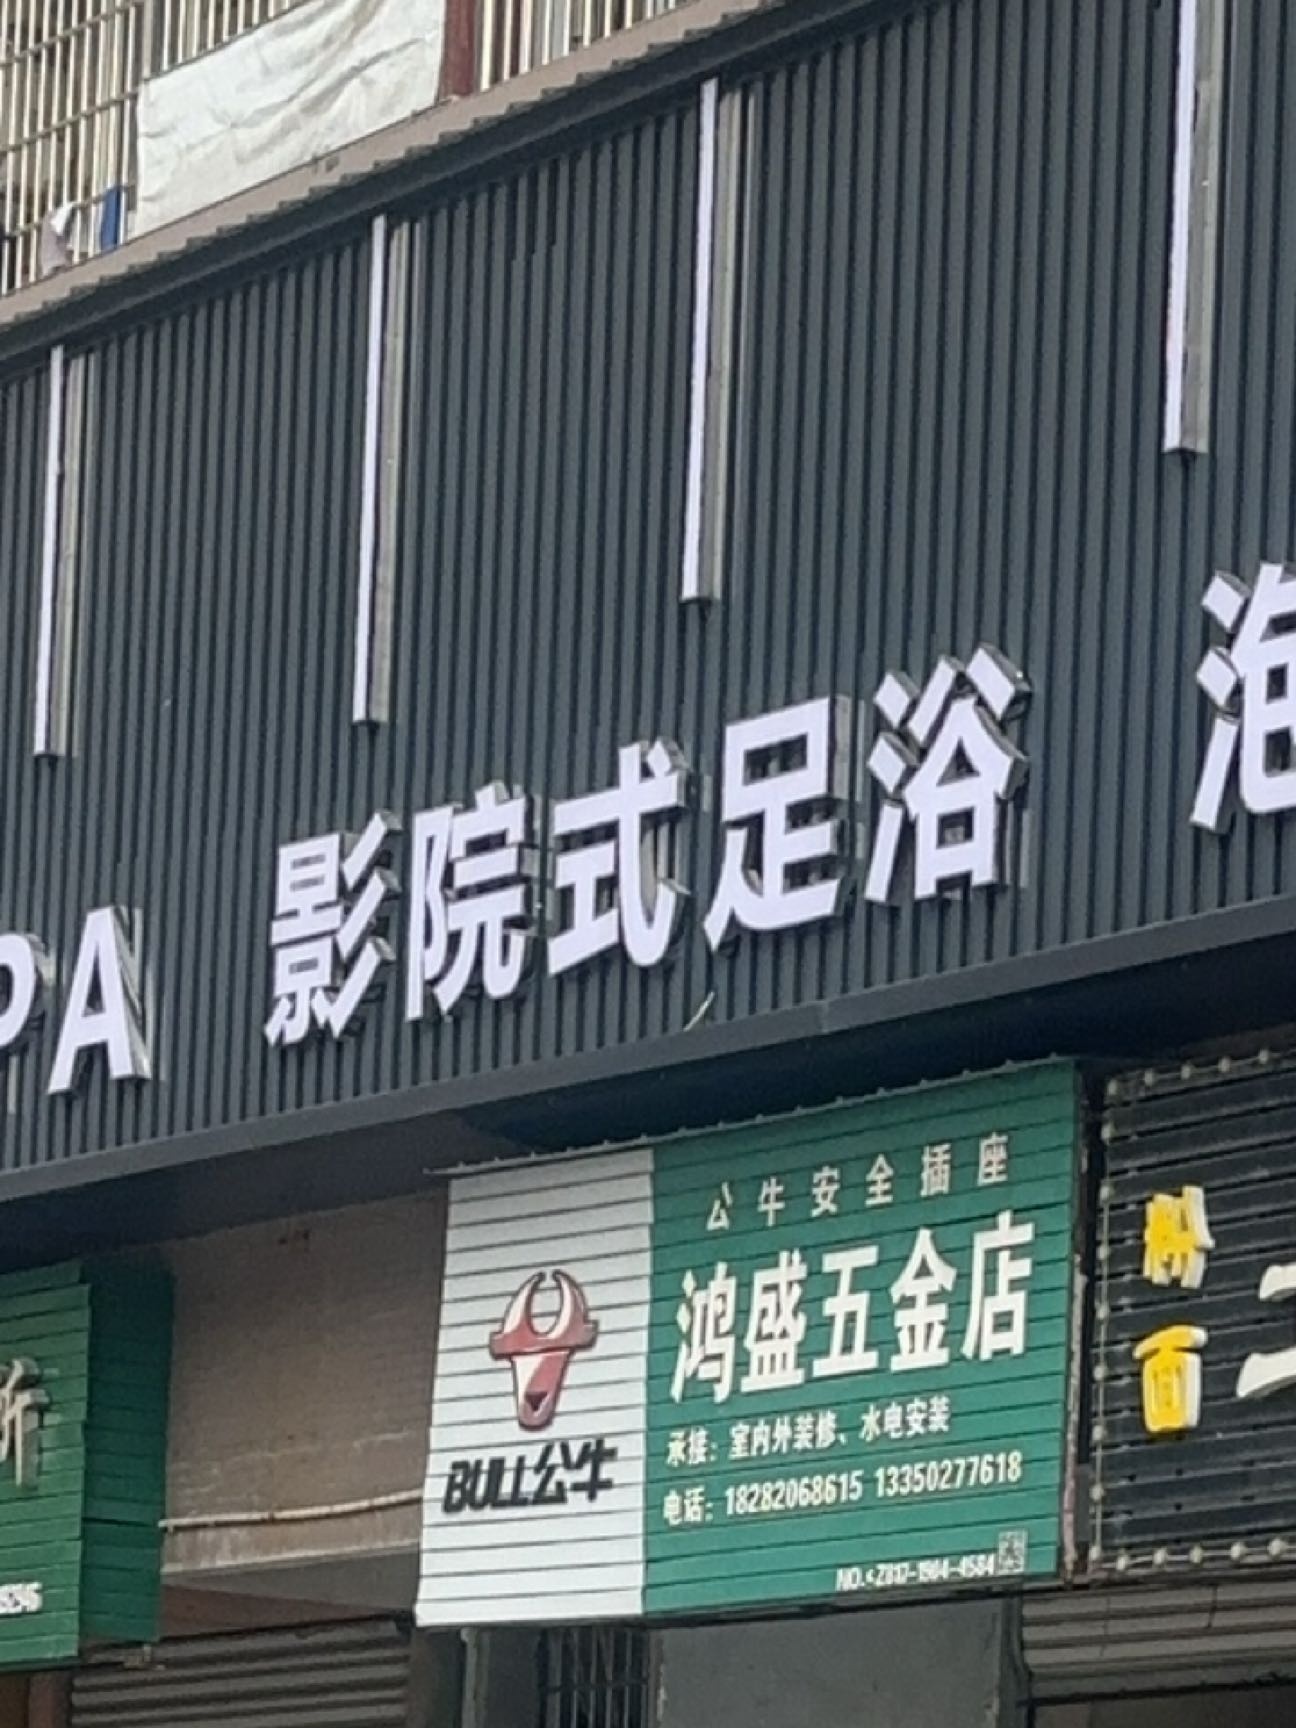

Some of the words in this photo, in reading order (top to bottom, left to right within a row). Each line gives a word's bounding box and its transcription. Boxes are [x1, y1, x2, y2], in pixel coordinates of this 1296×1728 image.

[264, 643, 1030, 1047] 影院式足浴
[706, 1133, 1010, 1231] 公牛安全插座
[669, 1209, 1036, 1403] 鸿盛五金店
[874, 1451, 1022, 1498] 13350277618
